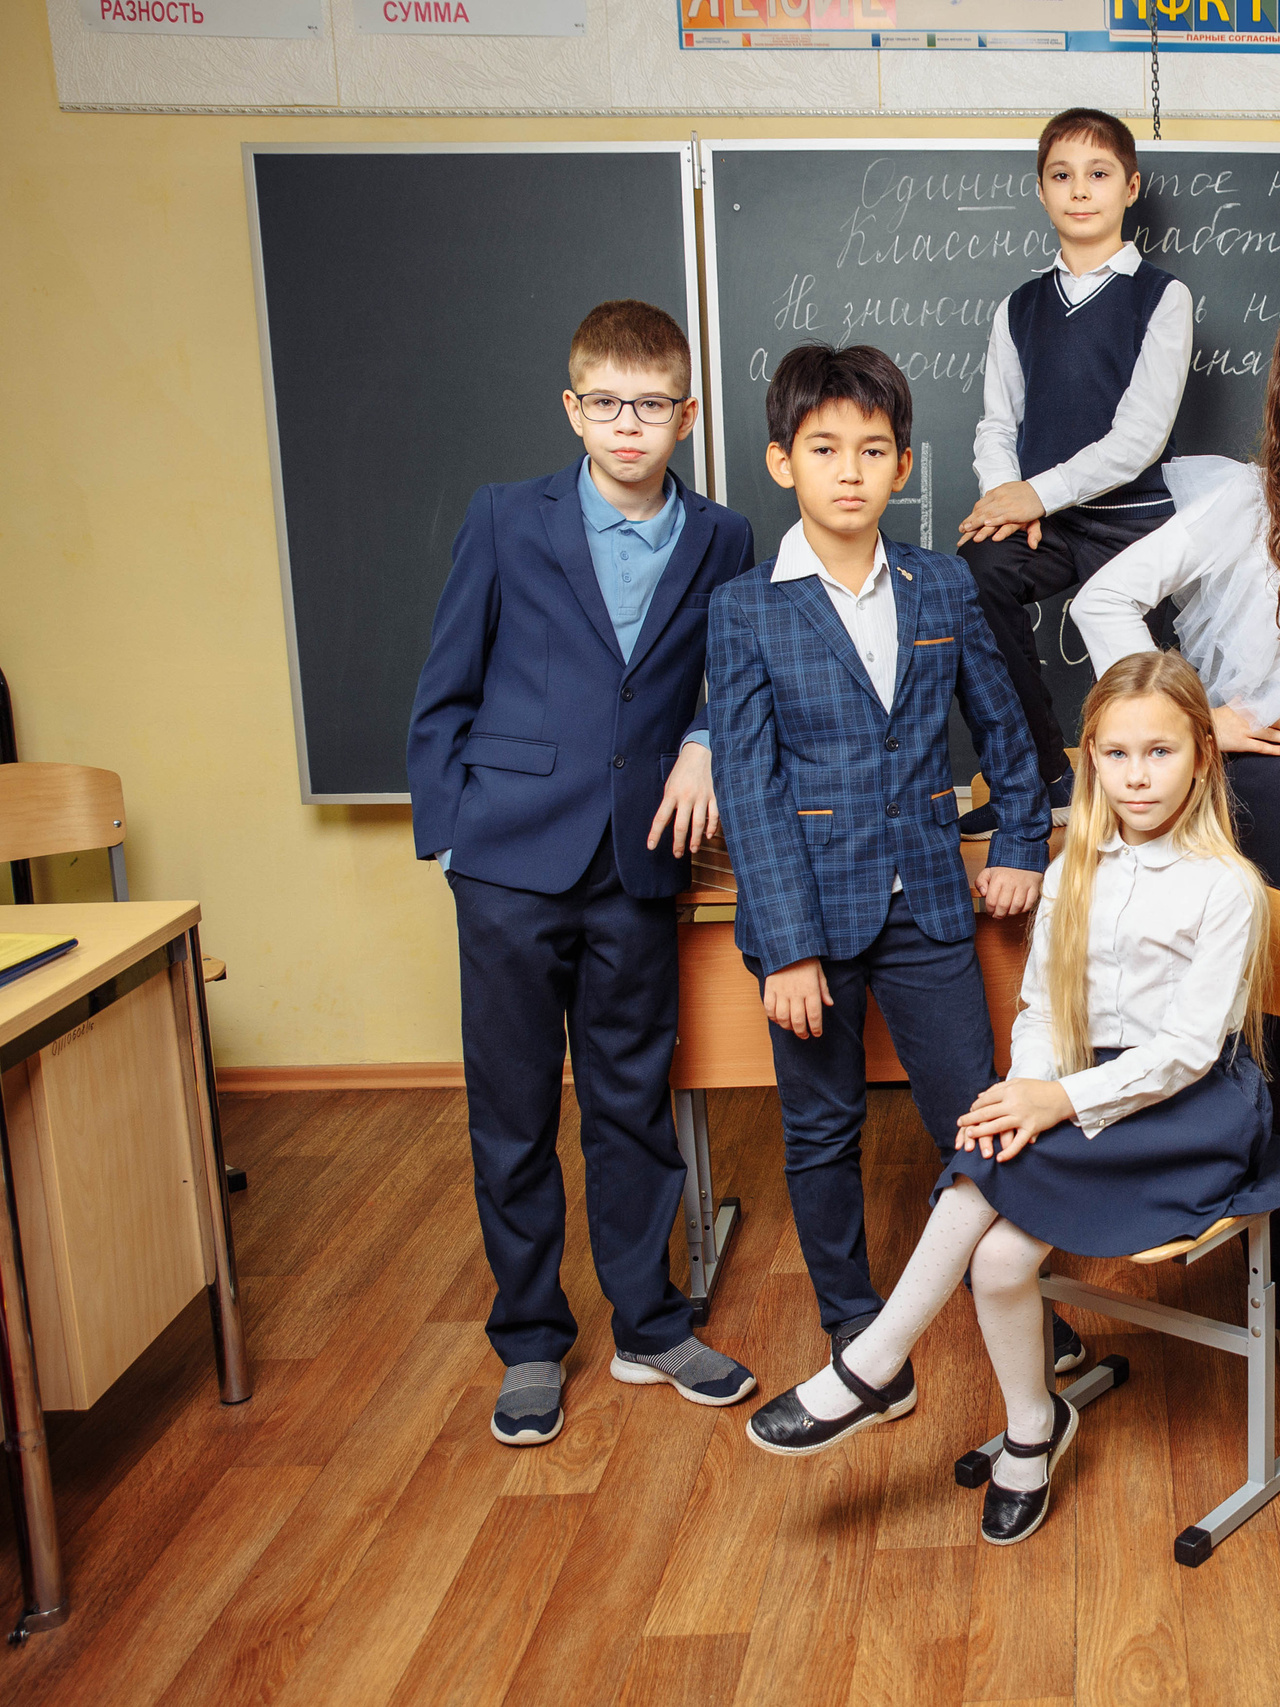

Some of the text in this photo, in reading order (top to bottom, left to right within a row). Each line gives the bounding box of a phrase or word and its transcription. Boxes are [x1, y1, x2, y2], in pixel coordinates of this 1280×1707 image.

[100, 0, 204, 24] РАЗНОСТЬ
[383, 1, 470, 23] СУММА
[1186, 33, 1226, 42] ПАРНЫЕ
[838, 206, 1063, 269] Классна
[772, 274, 827, 331] Не
